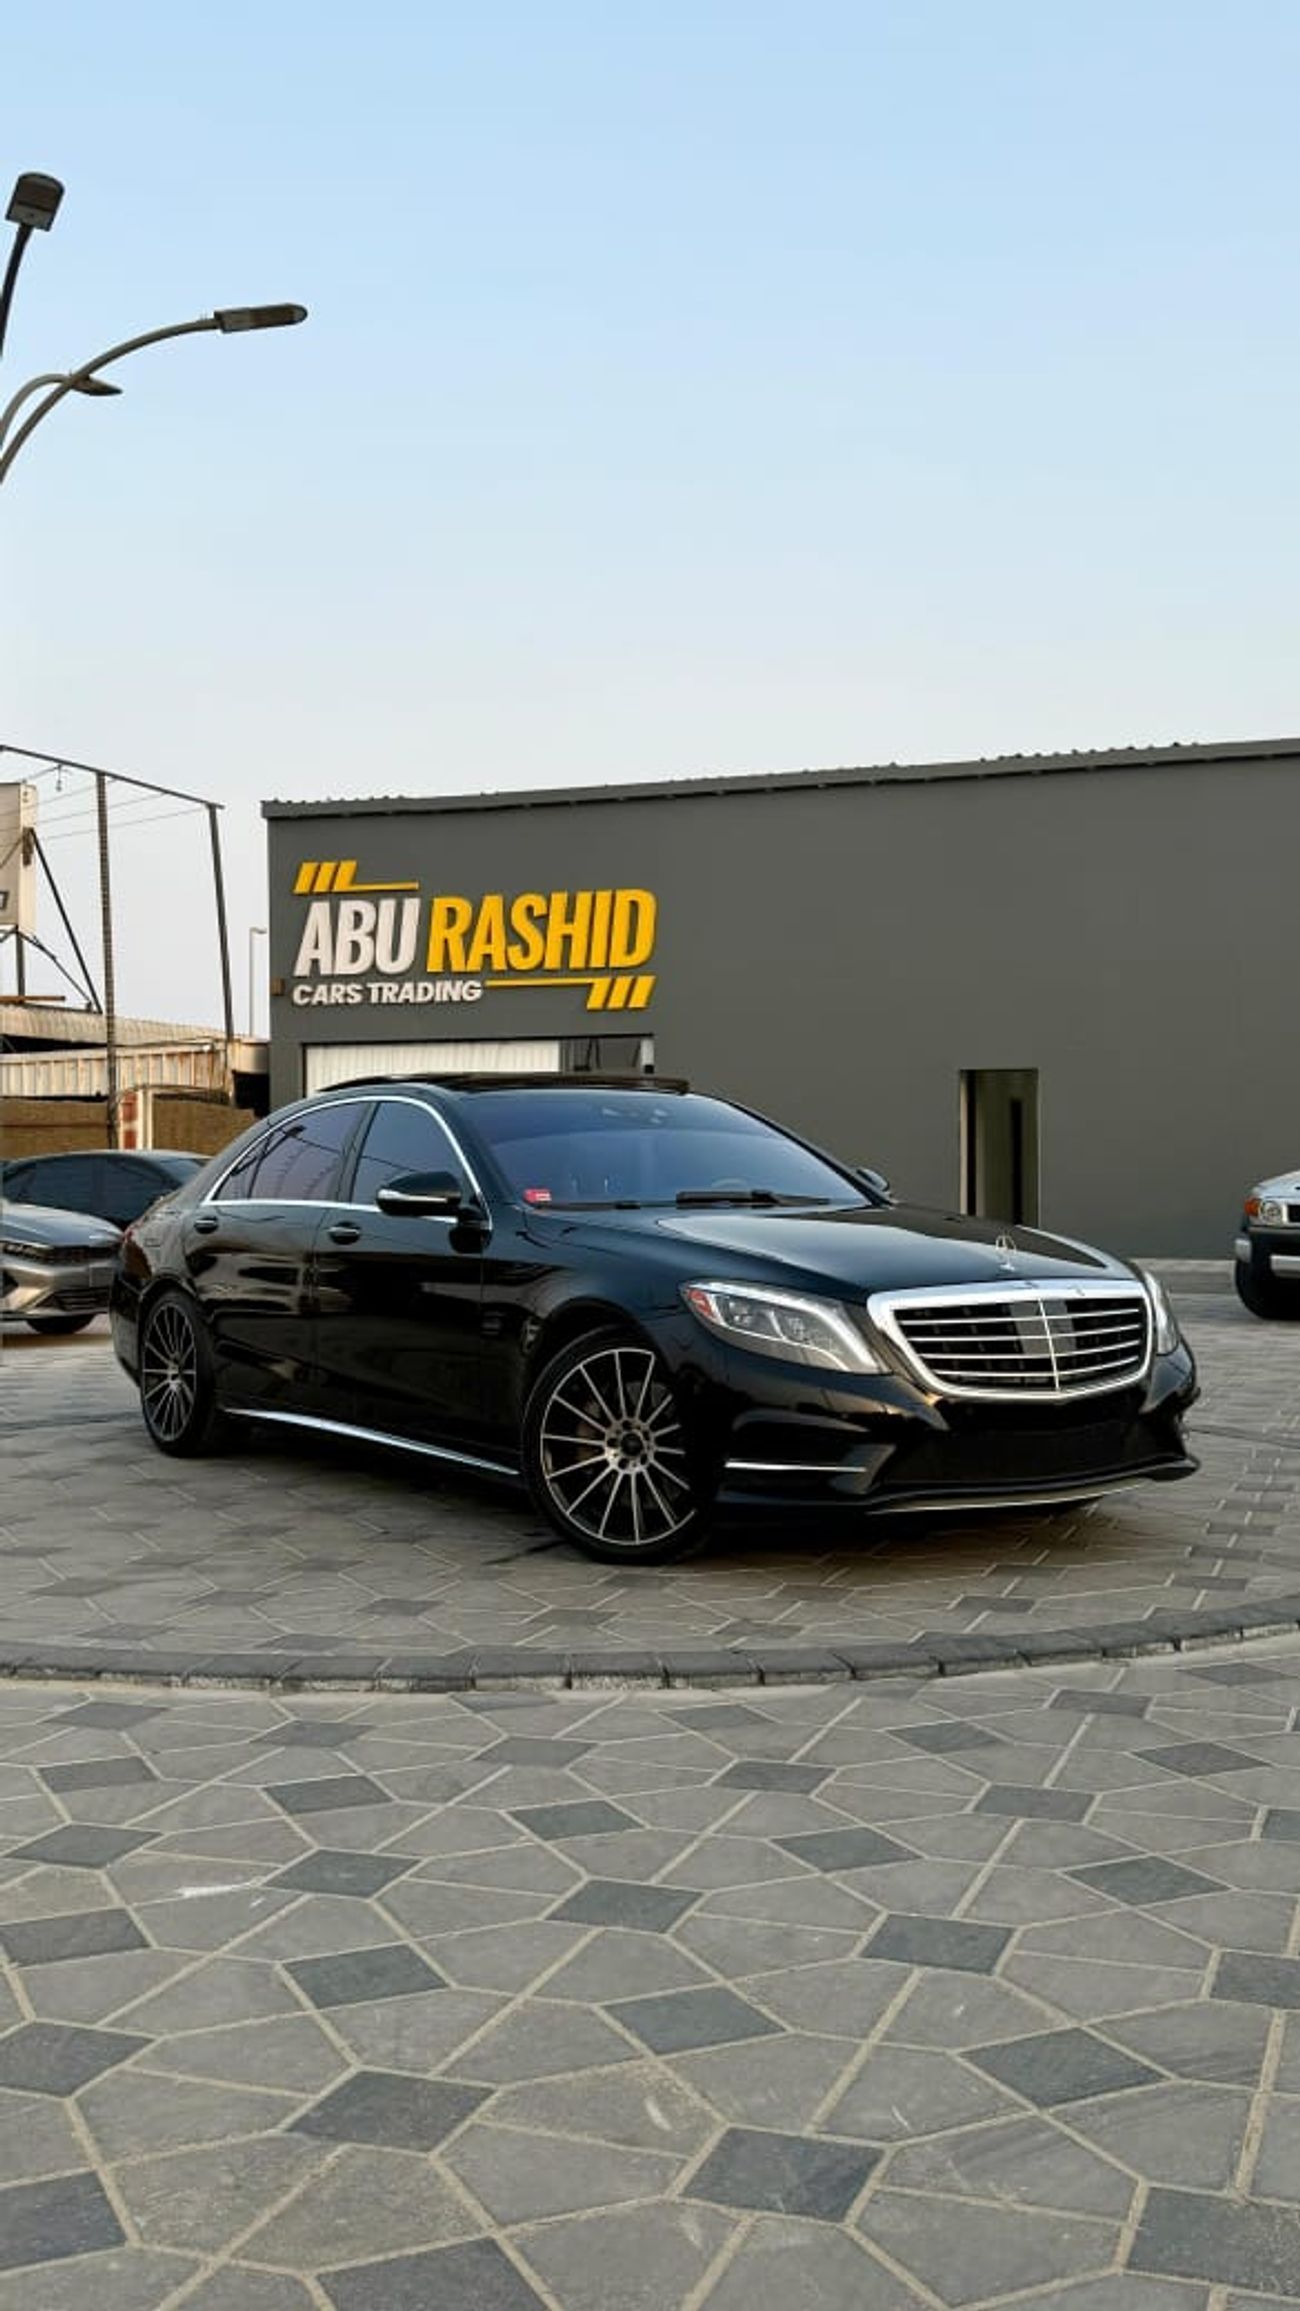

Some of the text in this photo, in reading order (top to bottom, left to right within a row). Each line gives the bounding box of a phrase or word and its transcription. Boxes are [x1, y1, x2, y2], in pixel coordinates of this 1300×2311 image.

[293, 888, 657, 976] ABU RASHID
[293, 980, 483, 1006] CARS TRADING
